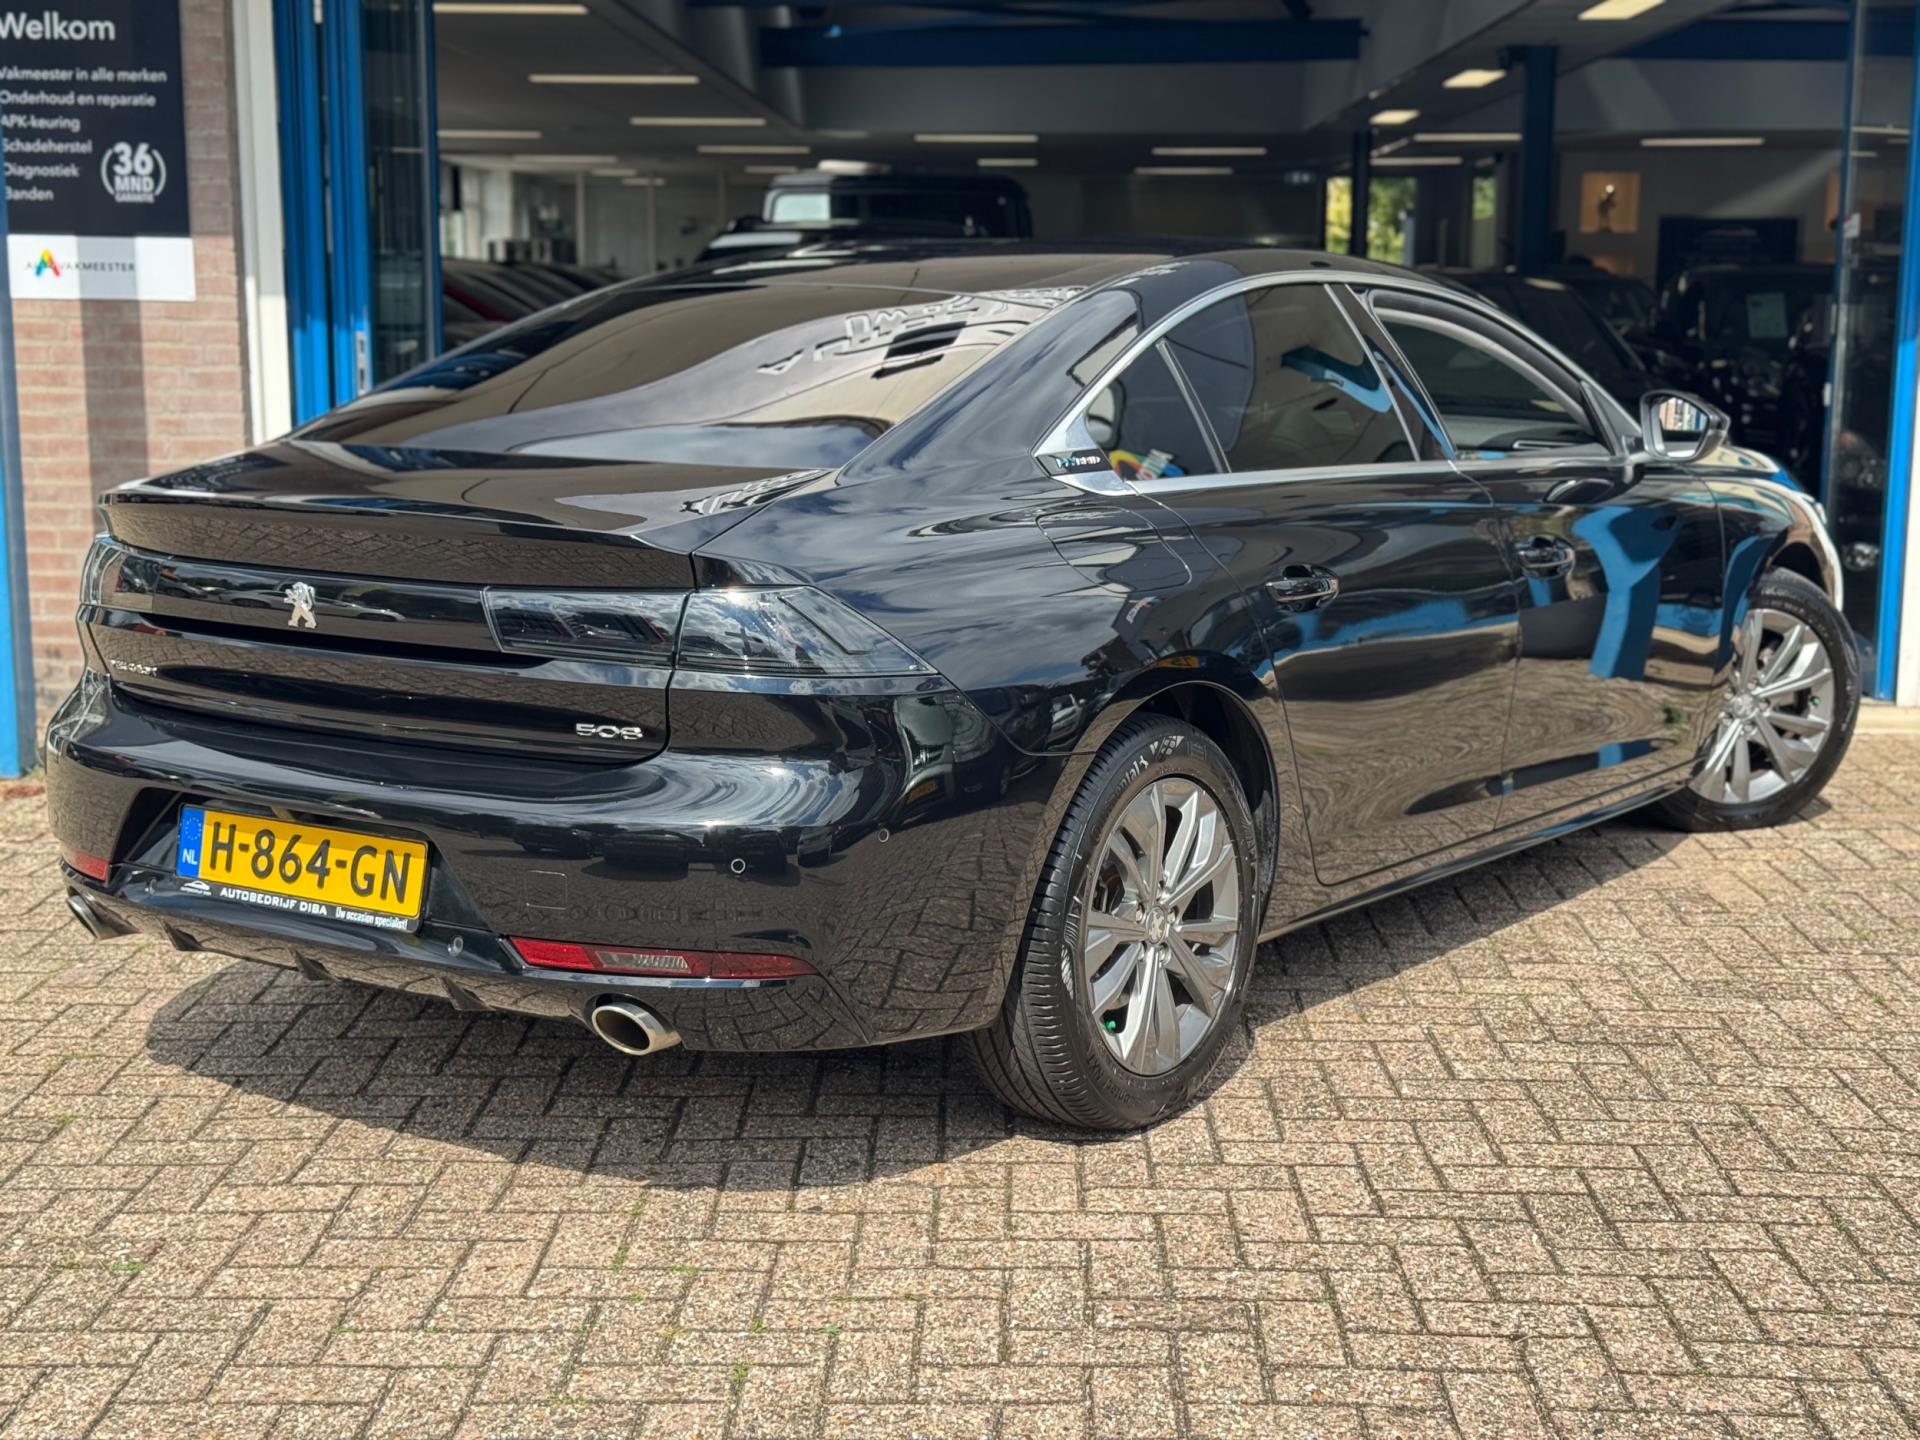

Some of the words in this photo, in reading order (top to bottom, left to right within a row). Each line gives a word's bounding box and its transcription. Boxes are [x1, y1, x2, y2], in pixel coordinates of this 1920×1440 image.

[0, 10, 116, 41] Welkom
[0, 66, 73, 81] Vakmeester
[75, 67, 88, 81] in
[91, 67, 114, 82] alle
[117, 68, 167, 82] merken
[0, 89, 75, 105] Onderhoud
[77, 94, 94, 105] en
[97, 93, 156, 109] reparatie
[1, 113, 81, 133] APK-keuring
[3, 138, 92, 153] Schadeherstel
[113, 142, 154, 176] 36
[114, 176, 154, 193] MND
[576, 723, 643, 740] 508
[182, 848, 198, 866] NL
[210, 821, 411, 903] H-864-GN
[220, 887, 297, 909] AUTOBEDRIJF
[299, 901, 327, 915] DIBA
[346, 911, 374, 924] occasion
